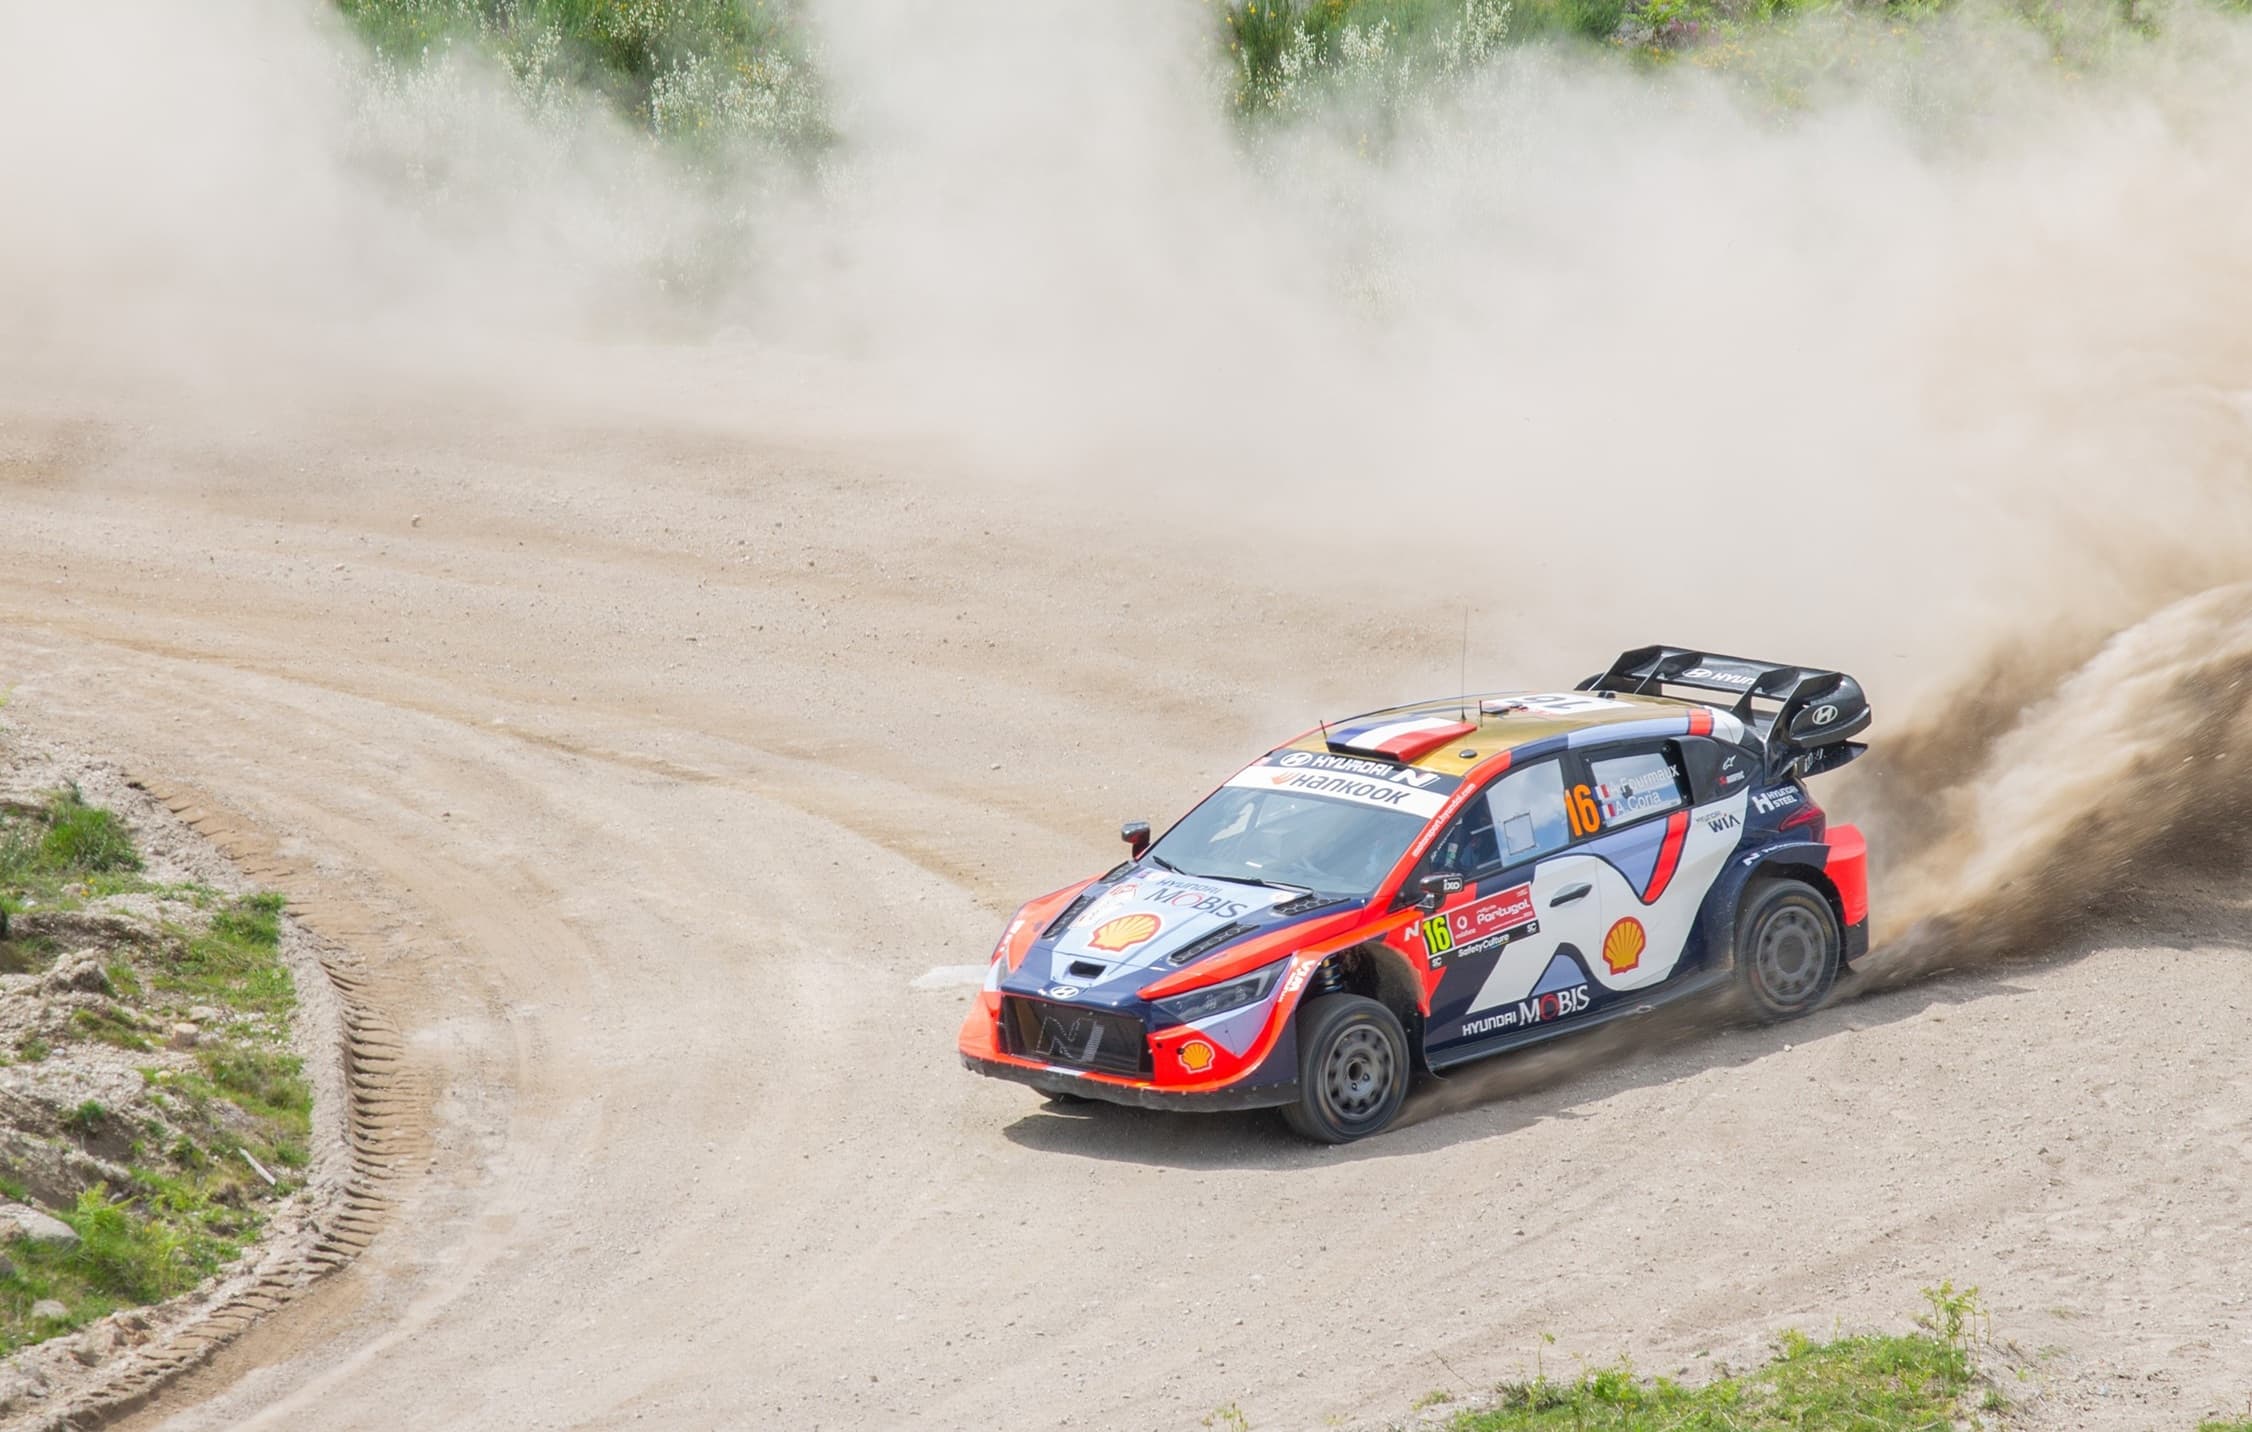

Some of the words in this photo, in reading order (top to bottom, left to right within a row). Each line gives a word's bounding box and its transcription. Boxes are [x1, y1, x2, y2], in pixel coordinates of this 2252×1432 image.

[1311, 755, 1395, 777] HYUNDAI
[1564, 783, 1601, 837] 16
[1772, 794, 1798, 808] STEEL
[1144, 887, 1248, 919] MOBIS
[1476, 899, 1531, 925] Portugal
[1404, 920, 1420, 941] N
[1423, 916, 1450, 954] 16
[1462, 1011, 1517, 1036] HYUNDAI
[1518, 985, 1590, 1026] MOBIS
